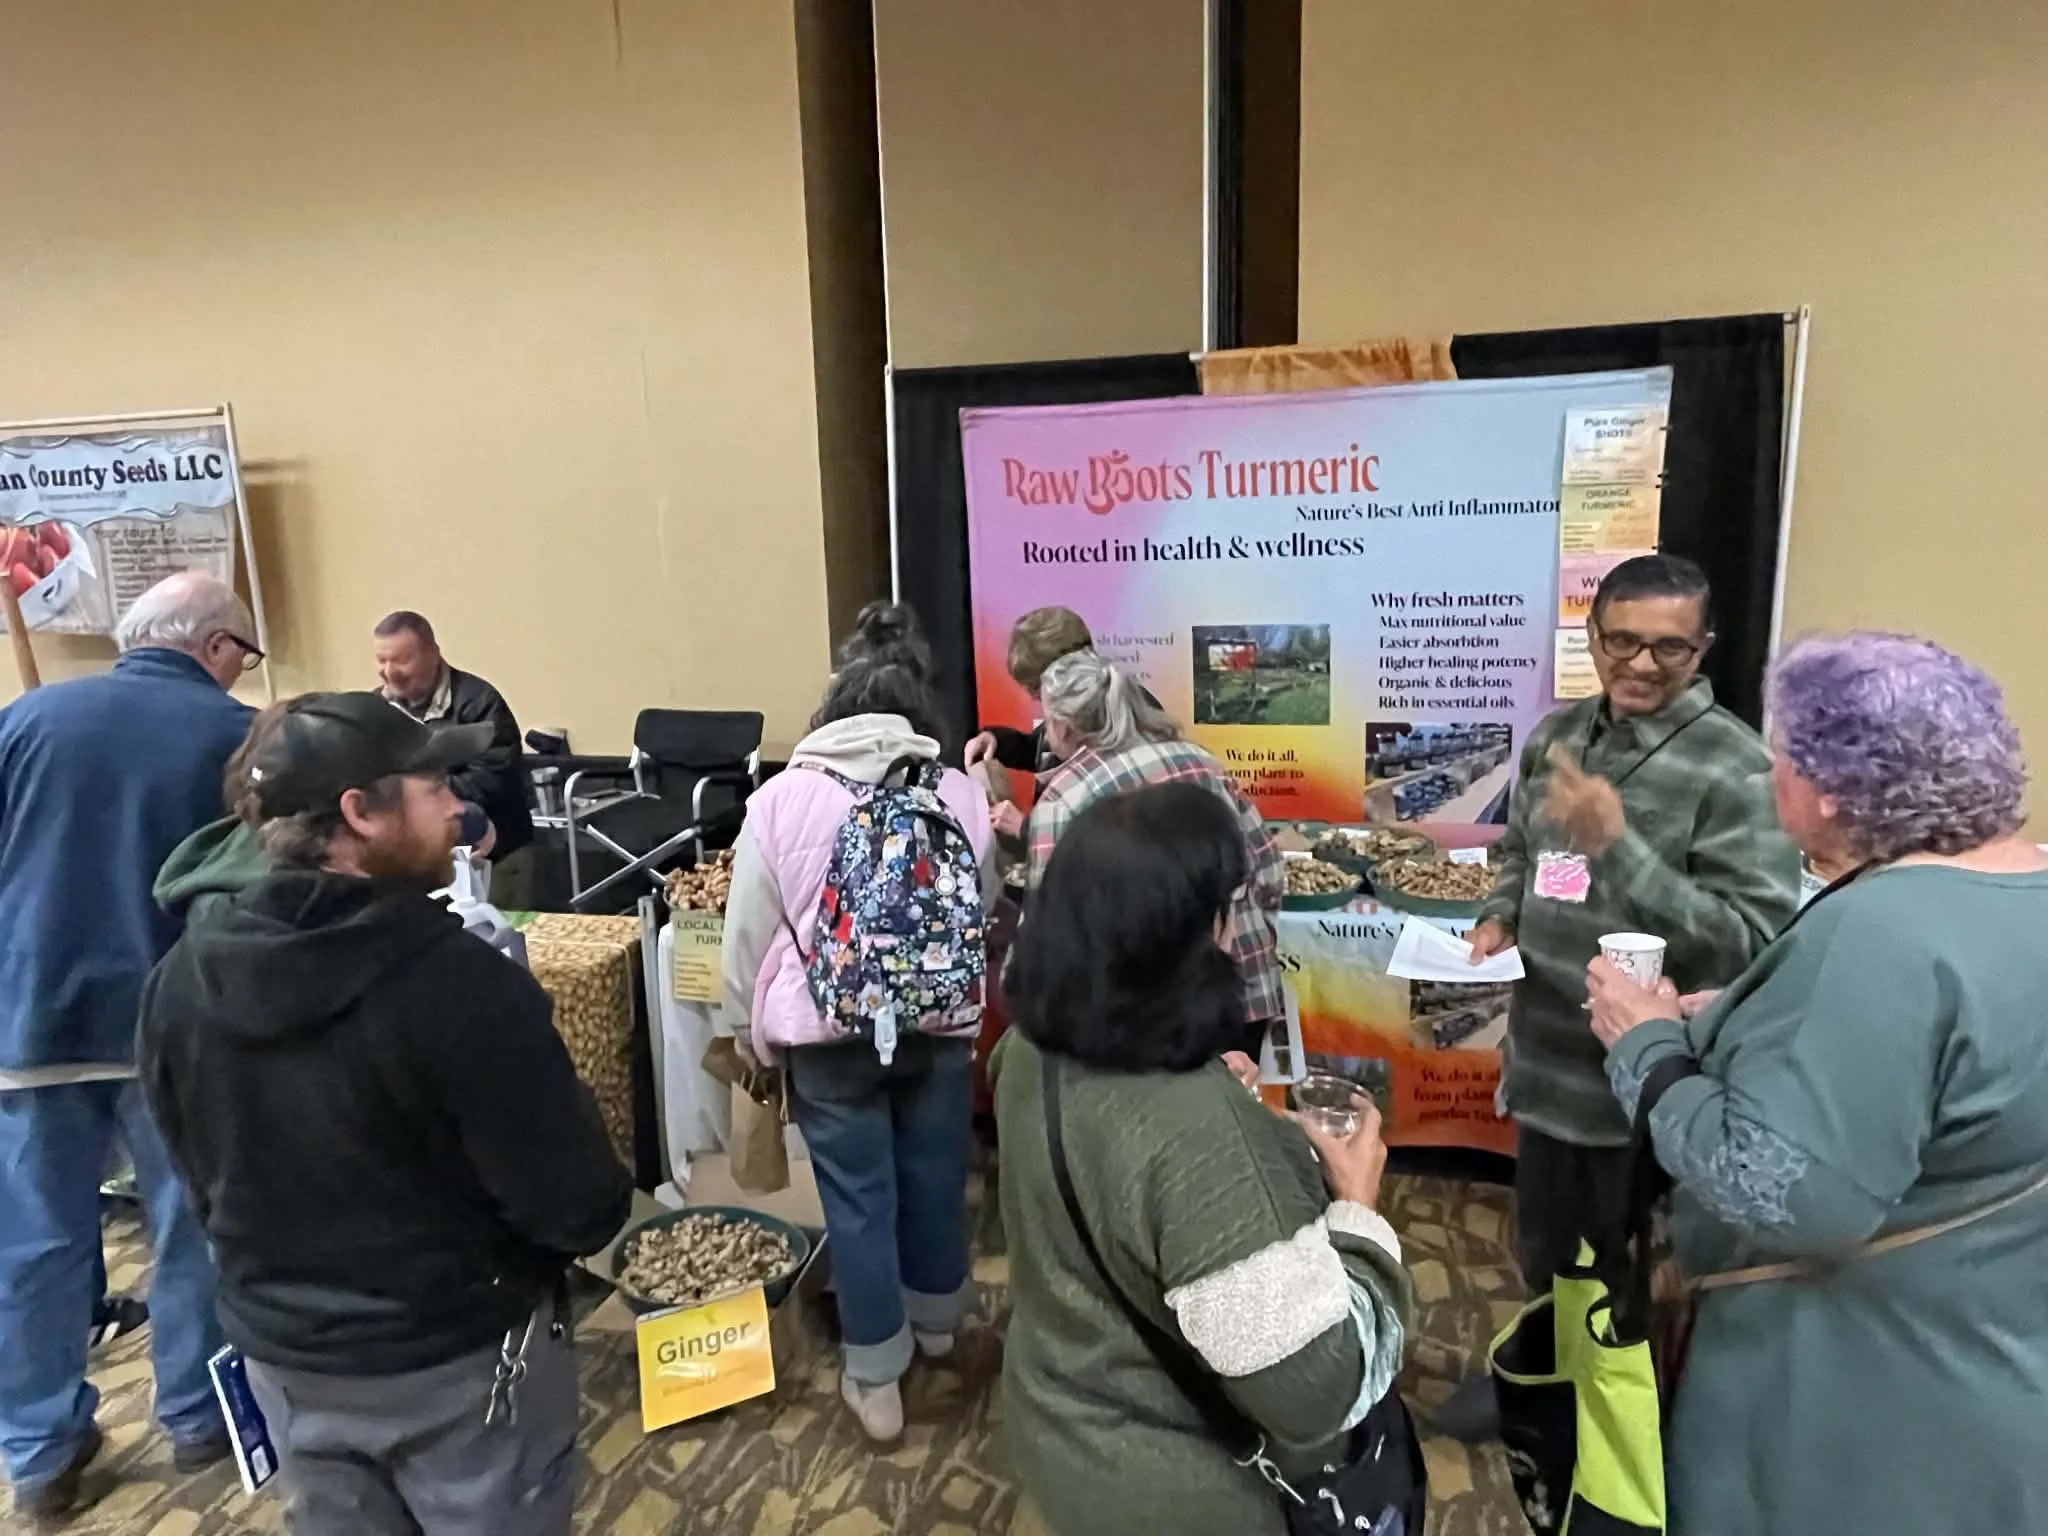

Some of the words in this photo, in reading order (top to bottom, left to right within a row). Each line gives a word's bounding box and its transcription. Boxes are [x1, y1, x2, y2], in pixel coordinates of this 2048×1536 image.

[29, 463, 108, 491] County
[112, 458, 168, 485] Seeds
[174, 454, 224, 481] LLC
[1002, 457, 1080, 506] Raw
[1199, 443, 1381, 499] Turmeric
[1296, 503, 1363, 522] Nature's
[1367, 503, 1402, 519] Best
[1407, 500, 1444, 518] Anti
[1023, 539, 1108, 564] Rooted
[1115, 538, 1137, 562] in
[1144, 536, 1222, 561] health
[1228, 536, 1249, 559] &
[1256, 532, 1365, 558] wellness
[1371, 592, 1408, 612] Why
[1412, 592, 1453, 608] fresh
[1458, 593, 1525, 607] matters
[1380, 615, 1408, 628] Max
[1411, 614, 1487, 628] nutritional
[1490, 613, 1526, 626] value
[1379, 635, 1420, 649] Easier
[1379, 655, 1425, 672] Higher
[1428, 655, 1478, 671] healing
[1481, 656, 1537, 672] potency
[1378, 675, 1432, 691] Organic
[1435, 676, 1447, 688] &
[1450, 675, 1513, 688] delicious
[1379, 695, 1408, 709] Rich
[1411, 695, 1425, 708] in
[1427, 694, 1487, 709] essential
[1490, 695, 1515, 708] oils
[1225, 748, 1244, 762] We
[1247, 748, 1265, 761] do
[1267, 748, 1278, 761] it
[677, 919, 717, 931] LOCAL
[1318, 918, 1395, 940] Nature's
[656, 1321, 751, 1365] Ginger
